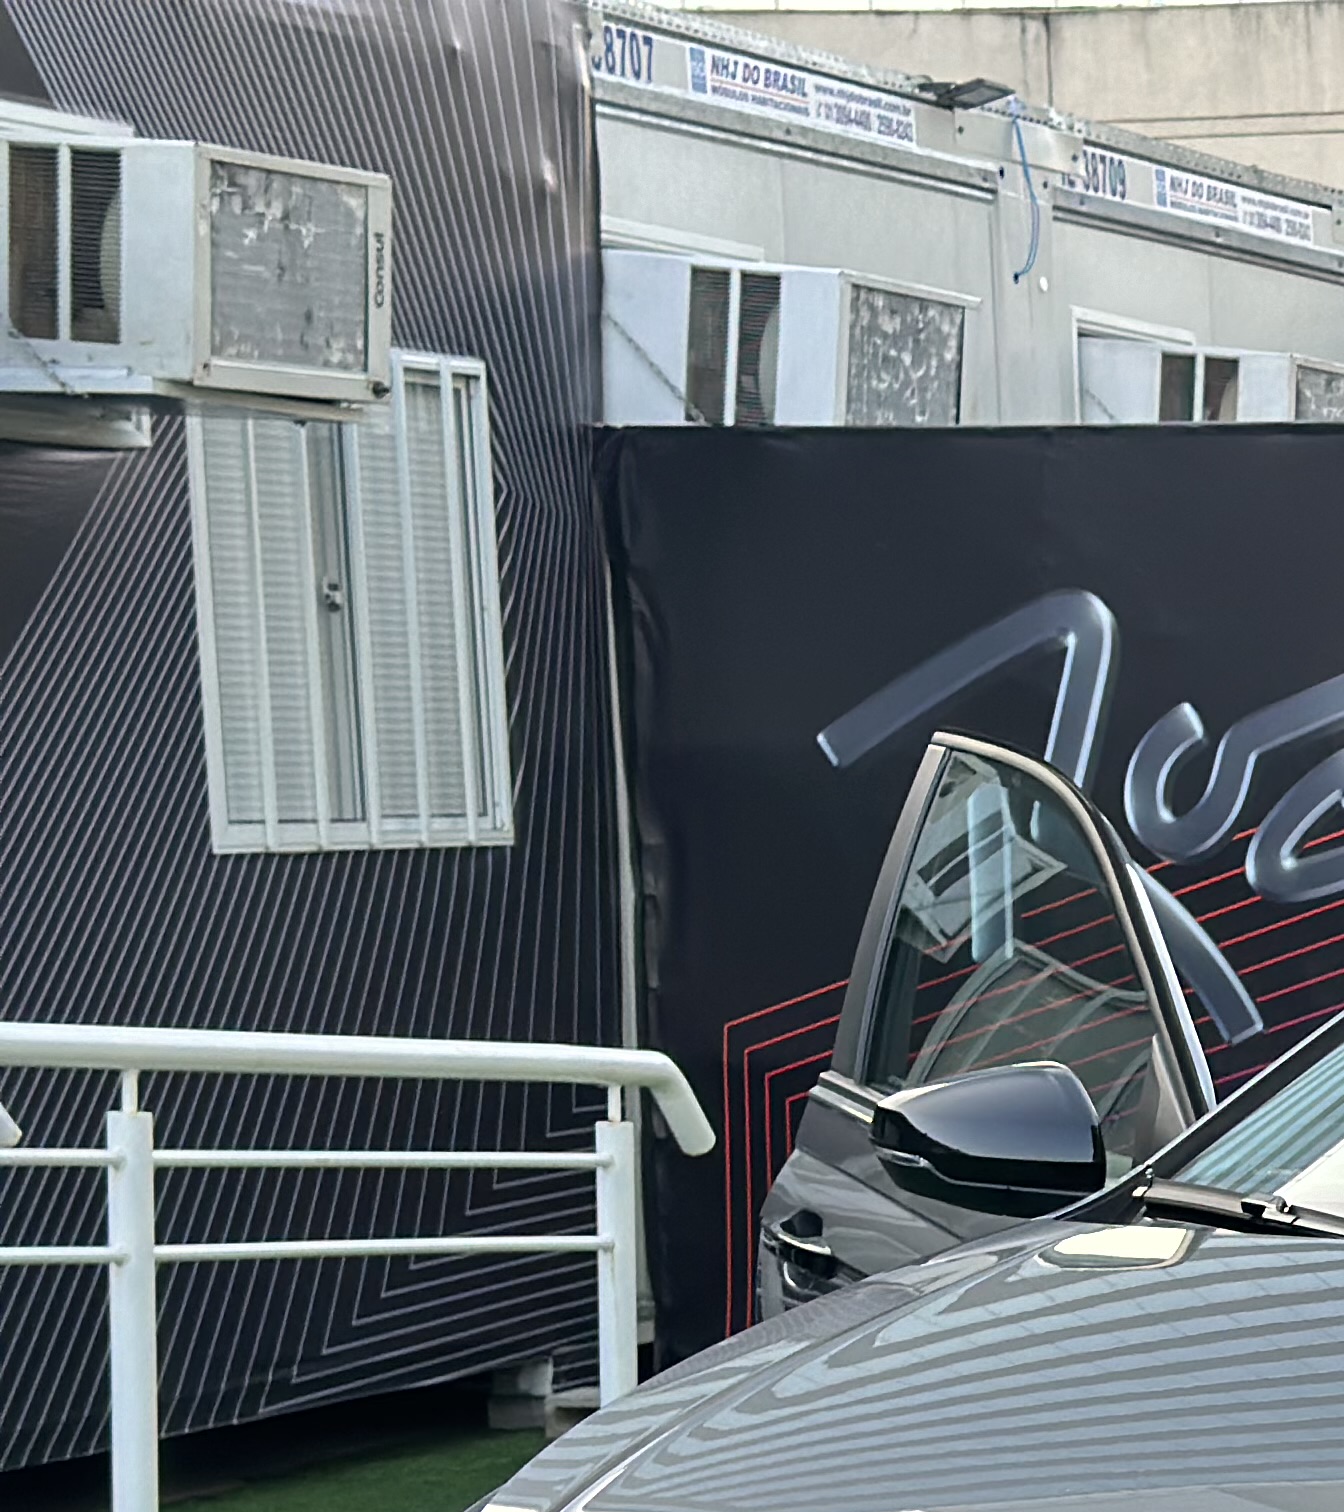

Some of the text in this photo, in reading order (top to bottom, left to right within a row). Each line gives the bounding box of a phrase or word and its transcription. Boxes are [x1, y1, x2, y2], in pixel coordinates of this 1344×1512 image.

[592, 25, 653, 84] 8707
[710, 54, 739, 80] NHJ
[742, 61, 761, 85] DO
[764, 68, 808, 98] BRASIL
